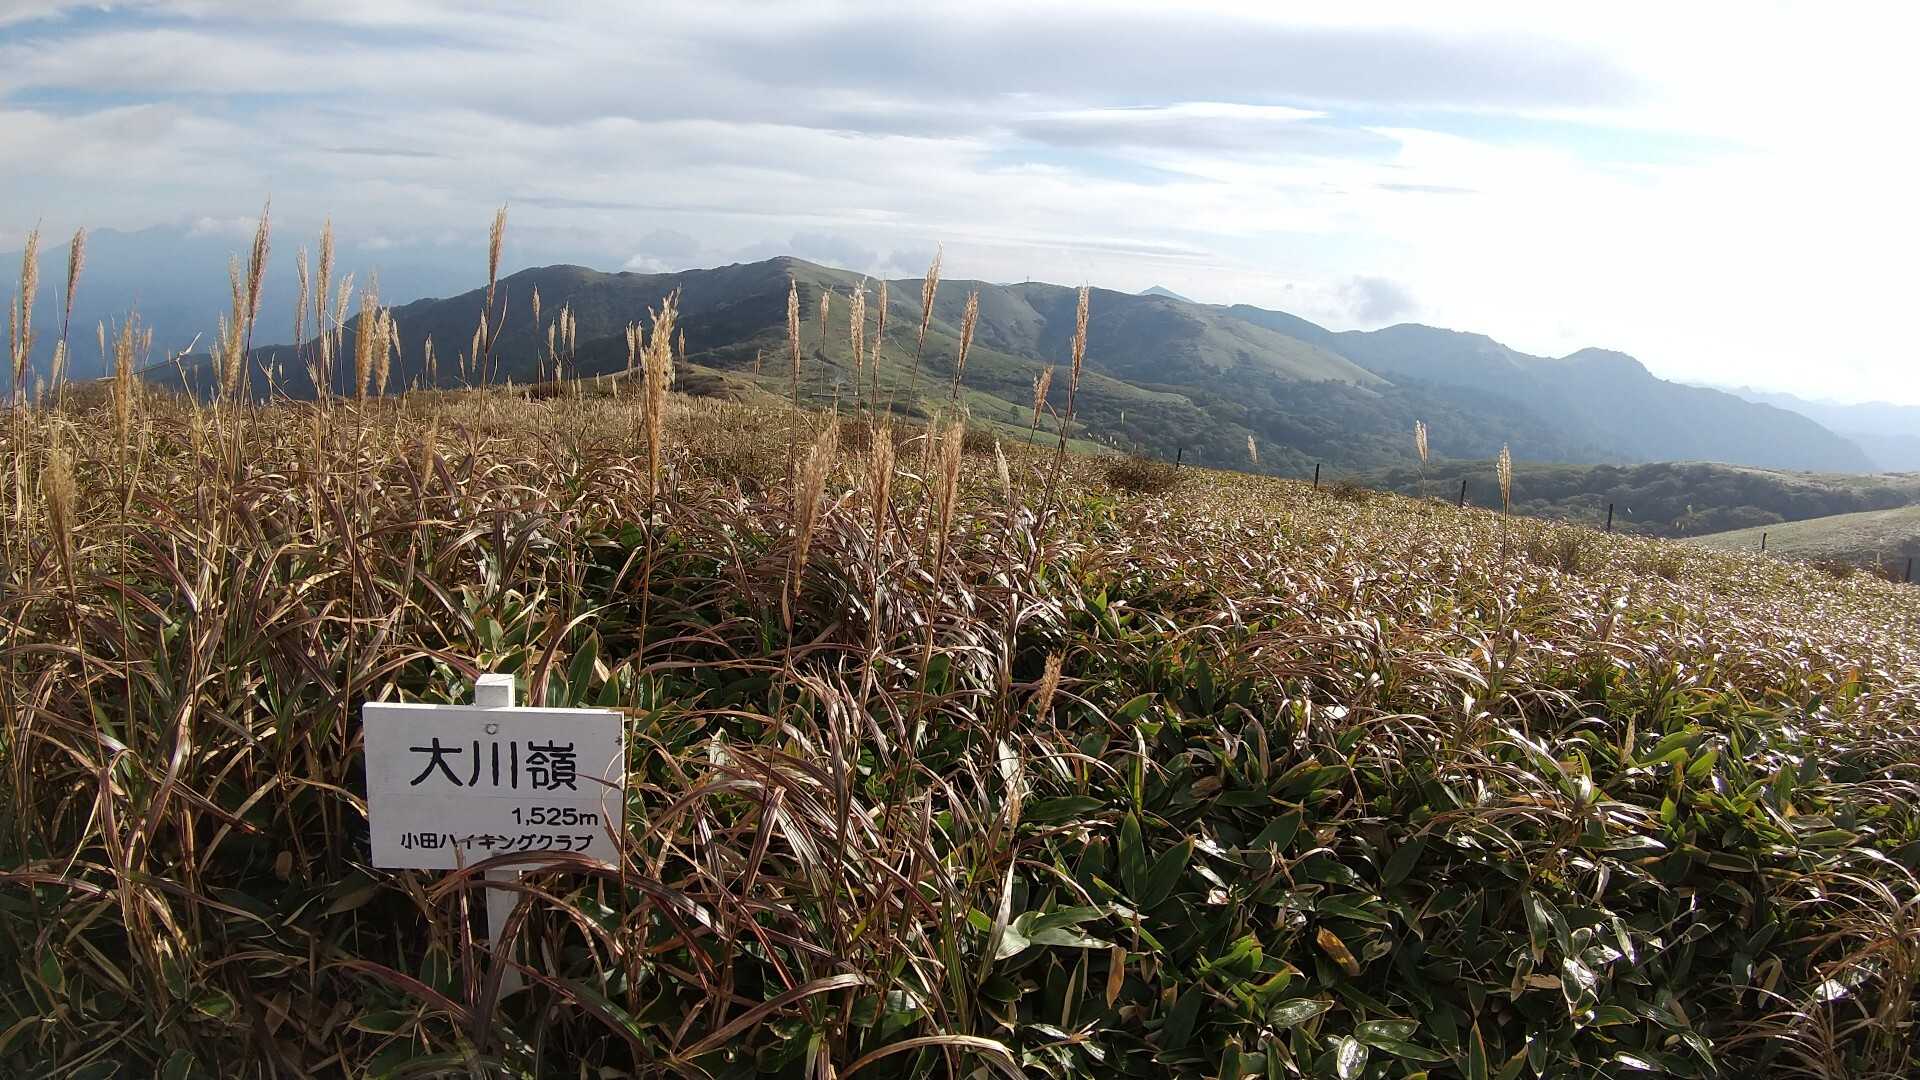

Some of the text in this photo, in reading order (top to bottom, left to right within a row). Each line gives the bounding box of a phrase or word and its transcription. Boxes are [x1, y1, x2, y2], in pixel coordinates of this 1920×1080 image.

[409, 738, 577, 791] 大川嶺
[511, 807, 598, 826] 1,525m
[401, 833, 594, 851] 小田ハイキングクラブ
